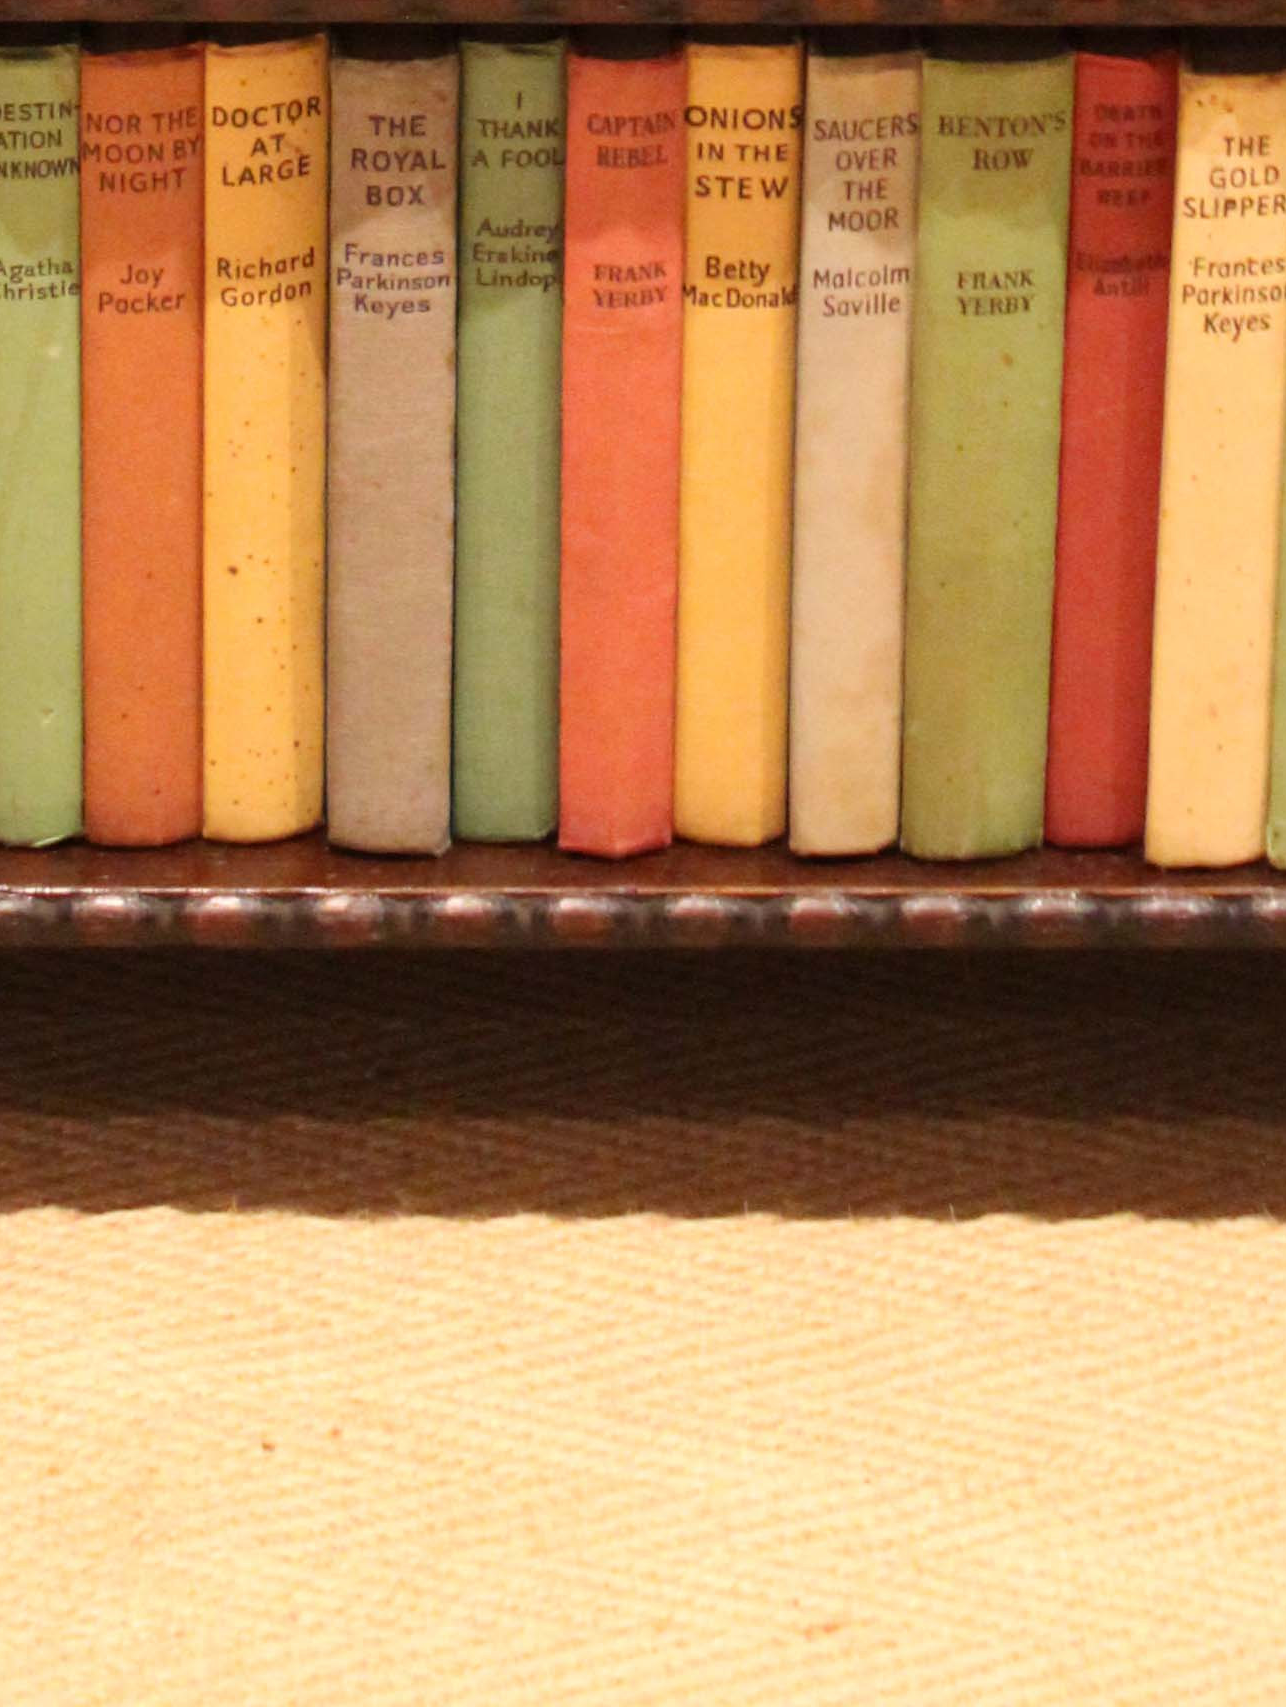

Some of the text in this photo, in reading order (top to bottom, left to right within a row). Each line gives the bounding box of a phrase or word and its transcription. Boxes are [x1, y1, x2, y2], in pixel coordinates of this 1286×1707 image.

[213, 97, 321, 127] DOCTOR
[517, 92, 522, 109] I
[86, 107, 197, 135] NOR THE
[369, 115, 425, 136] THE
[478, 118, 559, 139] THANK
[684, 105, 803, 129] ONIONS
[815, 113, 917, 141] SAUCERS
[939, 111, 1066, 137] BENTON'S
[83, 136, 201, 164] MOON BY
[251, 136, 286, 156] AT
[597, 145, 668, 168] REBEL
[697, 143, 788, 161] IN THE
[1224, 136, 1272, 157] THE
[351, 149, 446, 172] ROYAL
[471, 150, 565, 168] A FOOL
[836, 147, 897, 171] OVER
[974, 149, 1034, 171] ROW
[99, 168, 187, 192] NIGHT
[222, 156, 311, 186] LARGE
[1210, 165, 1279, 189] GOLD
[366, 186, 423, 207] BOX
[696, 177, 789, 199] STEW
[843, 179, 887, 201] THE
[477, 218, 558, 243] Audrey
[828, 210, 899, 232] MOOR
[217, 248, 315, 278] Richard
[345, 244, 444, 267] Frances
[120, 265, 164, 289] Joy
[336, 268, 450, 289] Parkinson
[476, 268, 556, 292] Lindop
[594, 261, 666, 283] FRANK
[706, 257, 770, 286] Betty
[814, 266, 910, 289] Malcolm
[958, 269, 1034, 289] FRANK
[221, 280, 312, 307] Gordon
[354, 297, 430, 320] Keyes
[822, 294, 900, 318] Saville
[1204, 312, 1271, 342] Keyes
